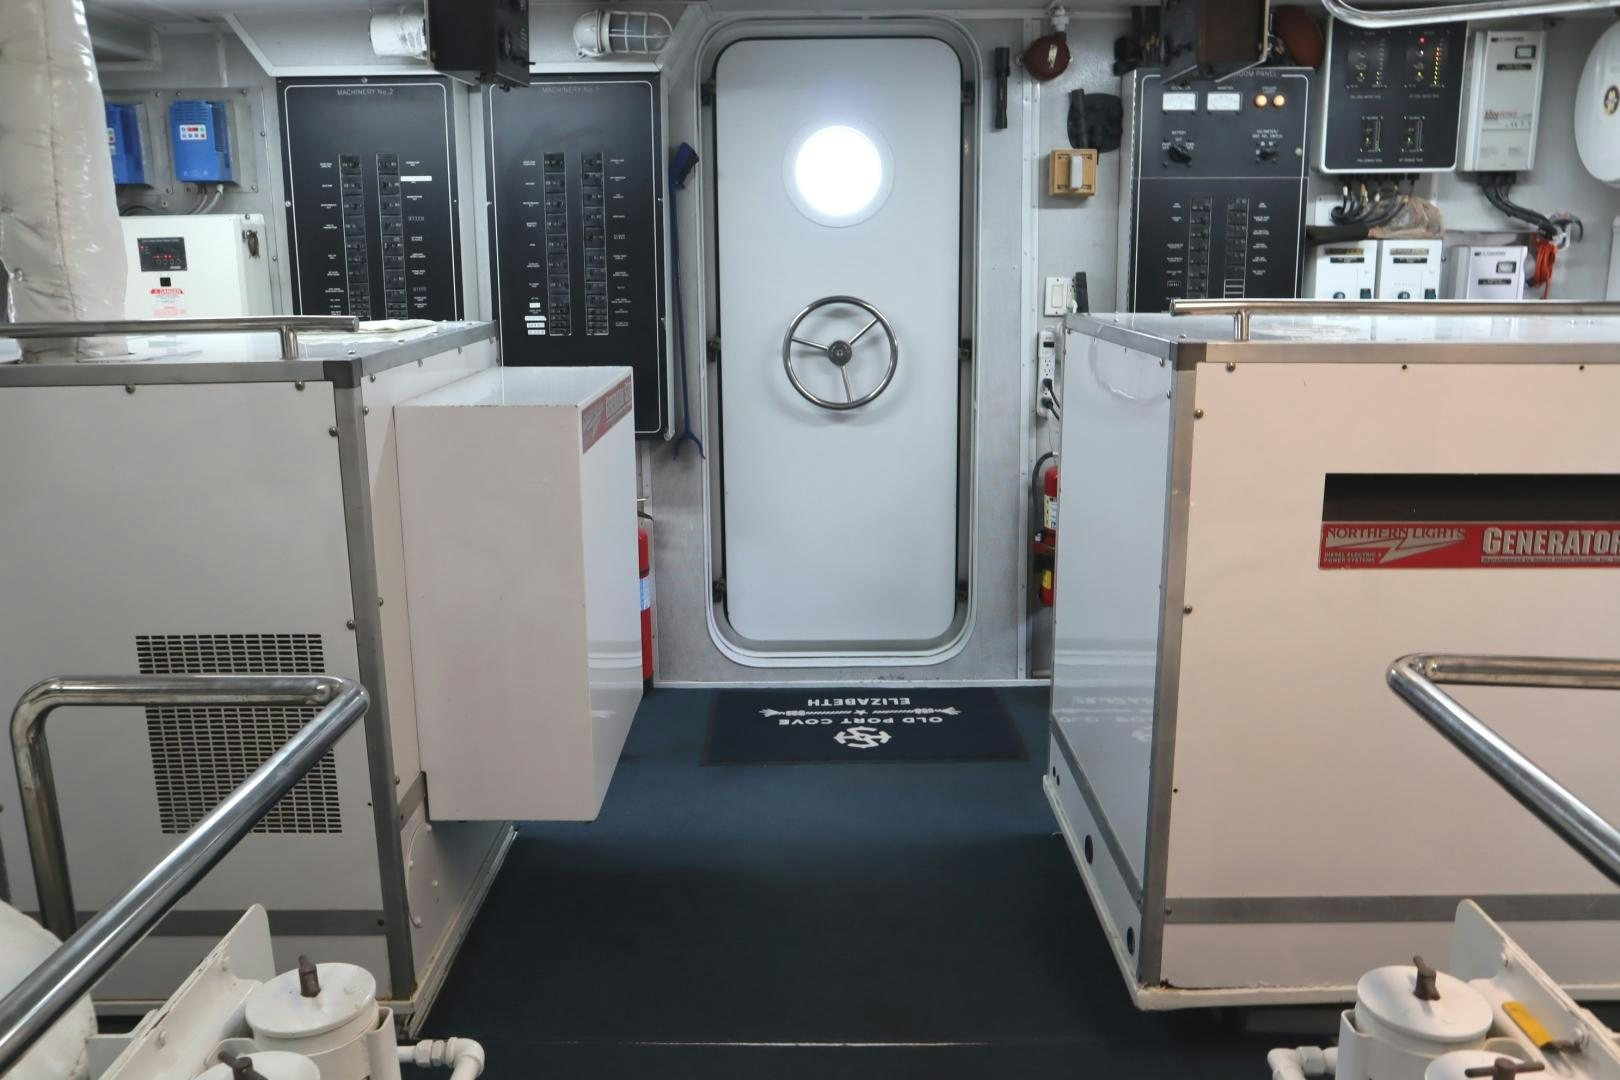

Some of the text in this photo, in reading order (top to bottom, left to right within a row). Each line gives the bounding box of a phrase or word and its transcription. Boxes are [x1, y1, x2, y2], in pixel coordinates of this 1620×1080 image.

[336, 88, 376, 96] MACHINERY
[1328, 528, 1466, 539] NORTHERN LIGHTS
[807, 698, 911, 707] ELIZABETH
[778, 716, 944, 726] OLD PORT COVE
